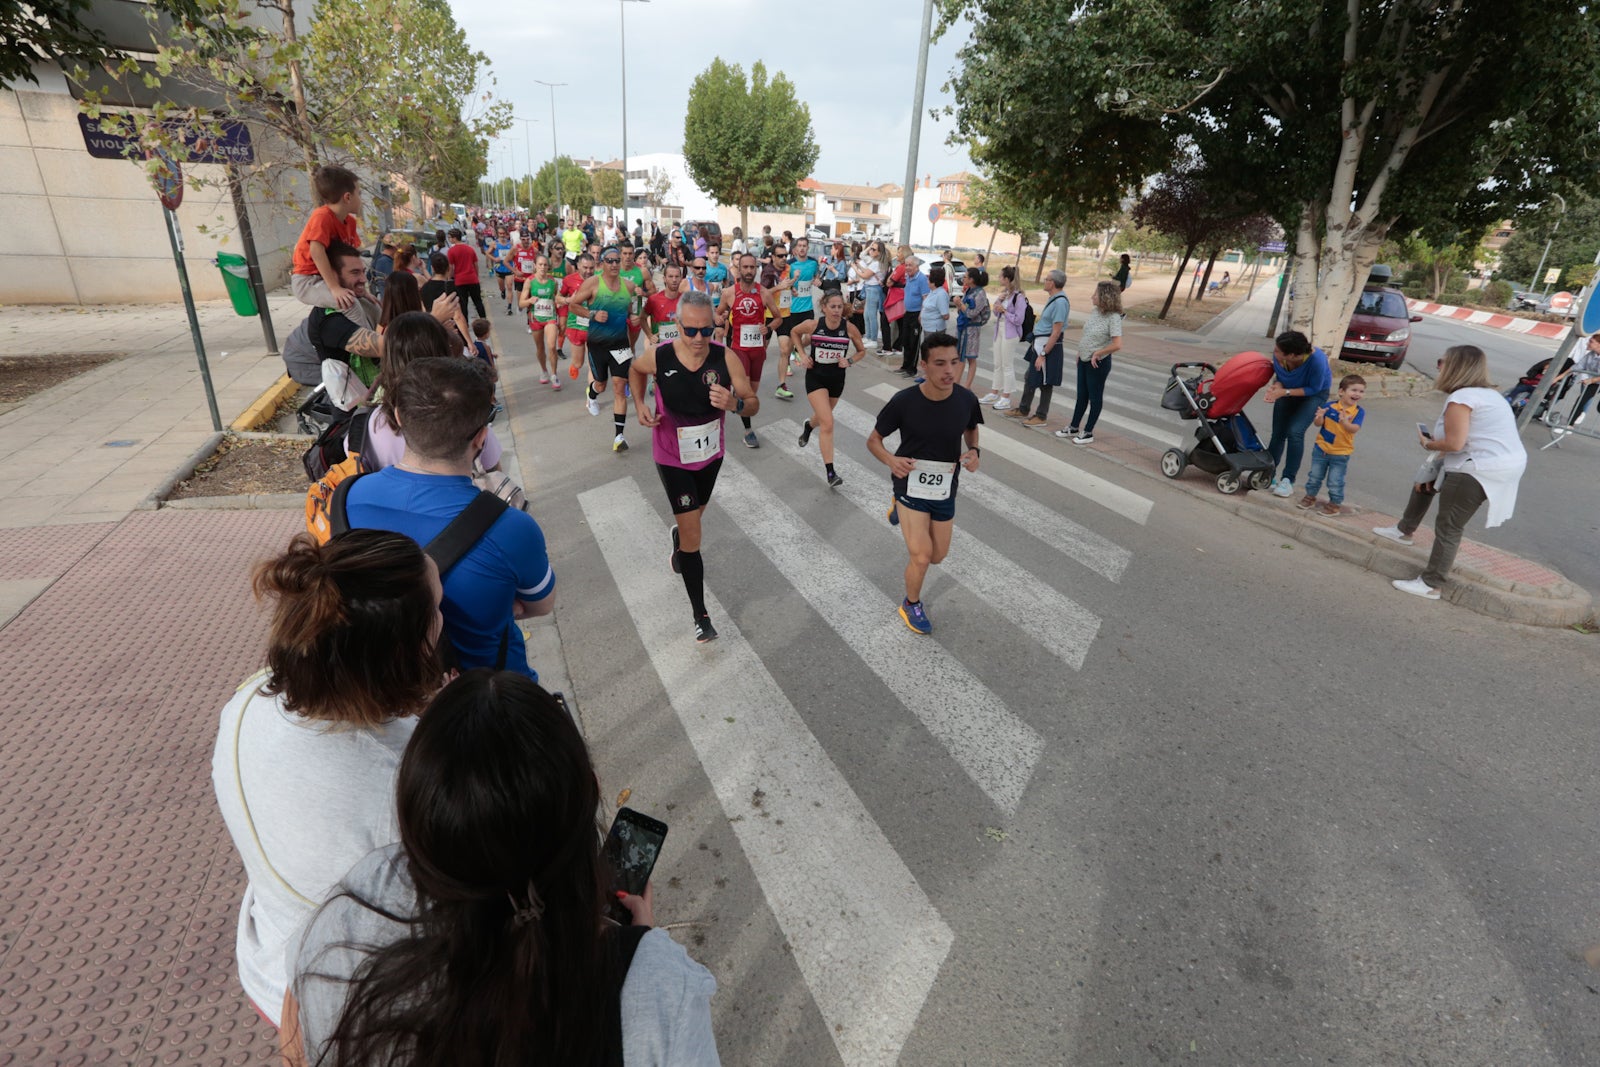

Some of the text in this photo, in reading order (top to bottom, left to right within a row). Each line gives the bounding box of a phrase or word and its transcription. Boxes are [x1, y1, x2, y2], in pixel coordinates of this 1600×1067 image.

[819, 350, 841, 359] 2125
[695, 436, 709, 449] 11
[919, 472, 943, 486] 629
